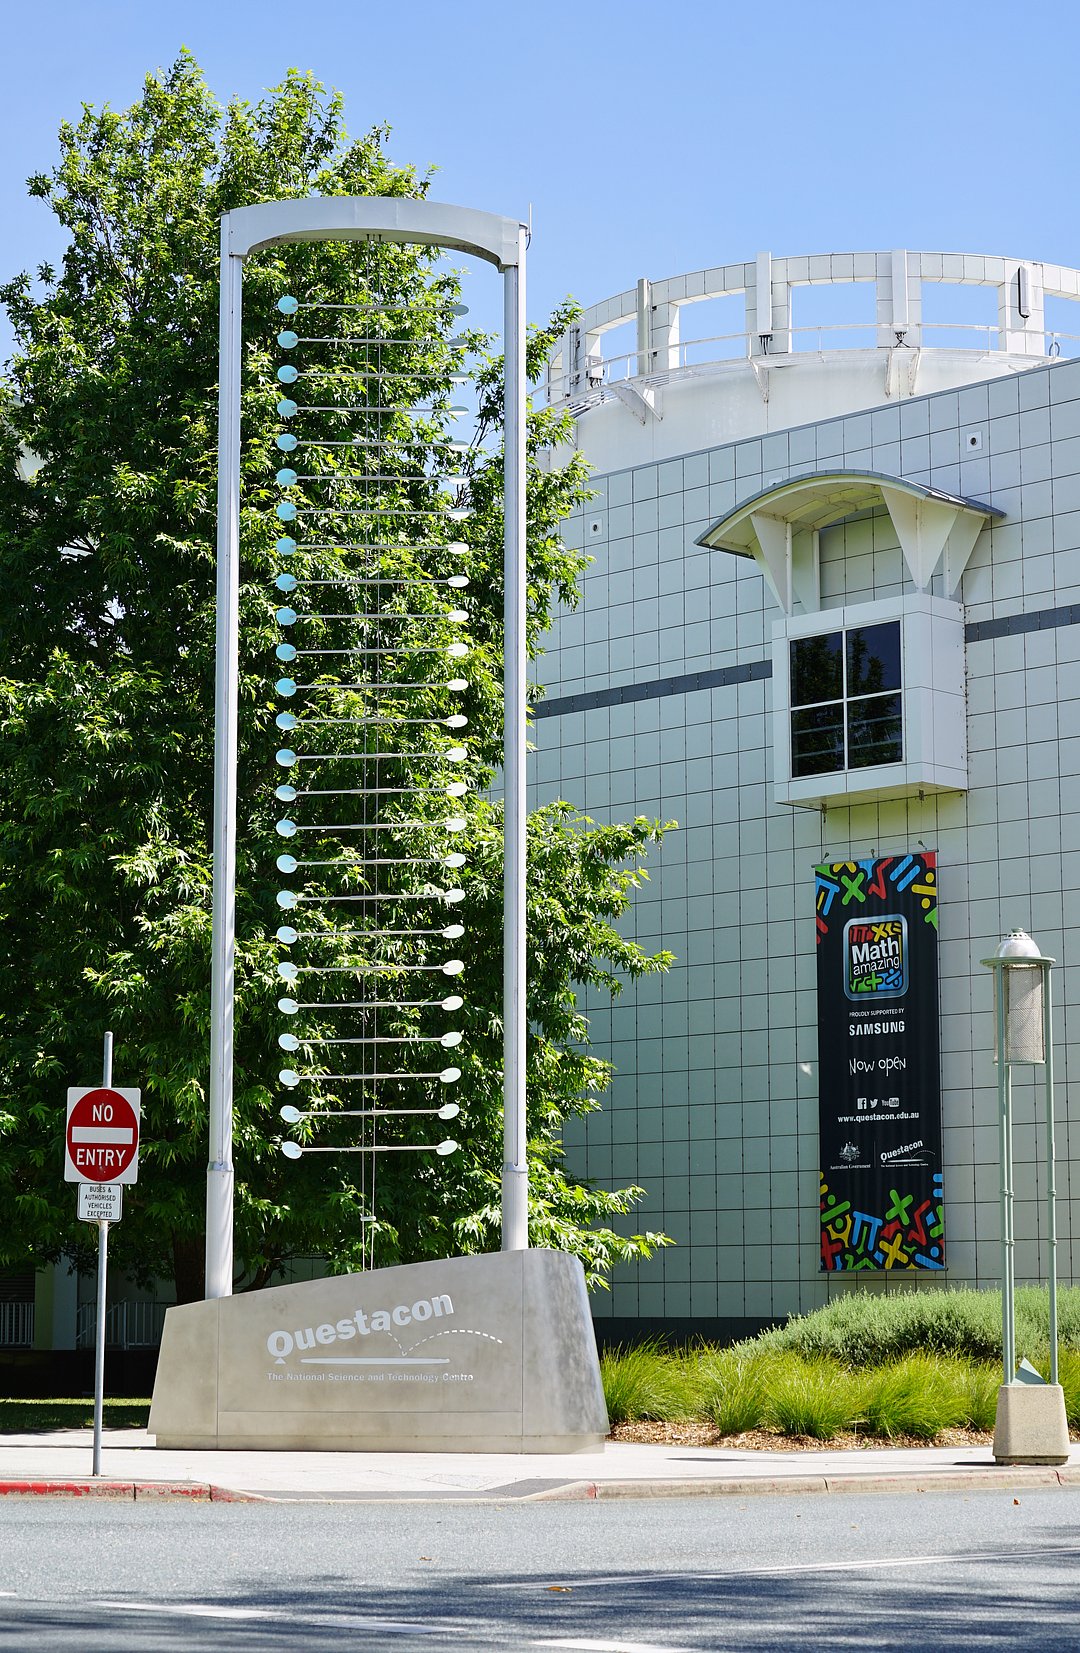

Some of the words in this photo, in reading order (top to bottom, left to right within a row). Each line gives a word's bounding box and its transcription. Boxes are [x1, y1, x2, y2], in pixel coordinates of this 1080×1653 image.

[851, 937, 899, 964] Math
[853, 956, 900, 975] amazing
[870, 1008, 898, 1016] SUPPORTED
[849, 1020, 905, 1036] SAMSUNG
[849, 1057, 875, 1076] Now
[92, 1104, 114, 1122] NO
[837, 1112, 919, 1122] www.questacon.edu.au
[76, 1148, 126, 1166] ENTRY
[880, 1140, 923, 1163] Questacon
[266, 1294, 454, 1364] Questacon
[267, 1372, 284, 1381] The
[286, 1372, 326, 1381] National
[328, 1372, 364, 1381] Science
[367, 1372, 384, 1381] and
[387, 1372, 439, 1383] Technology
